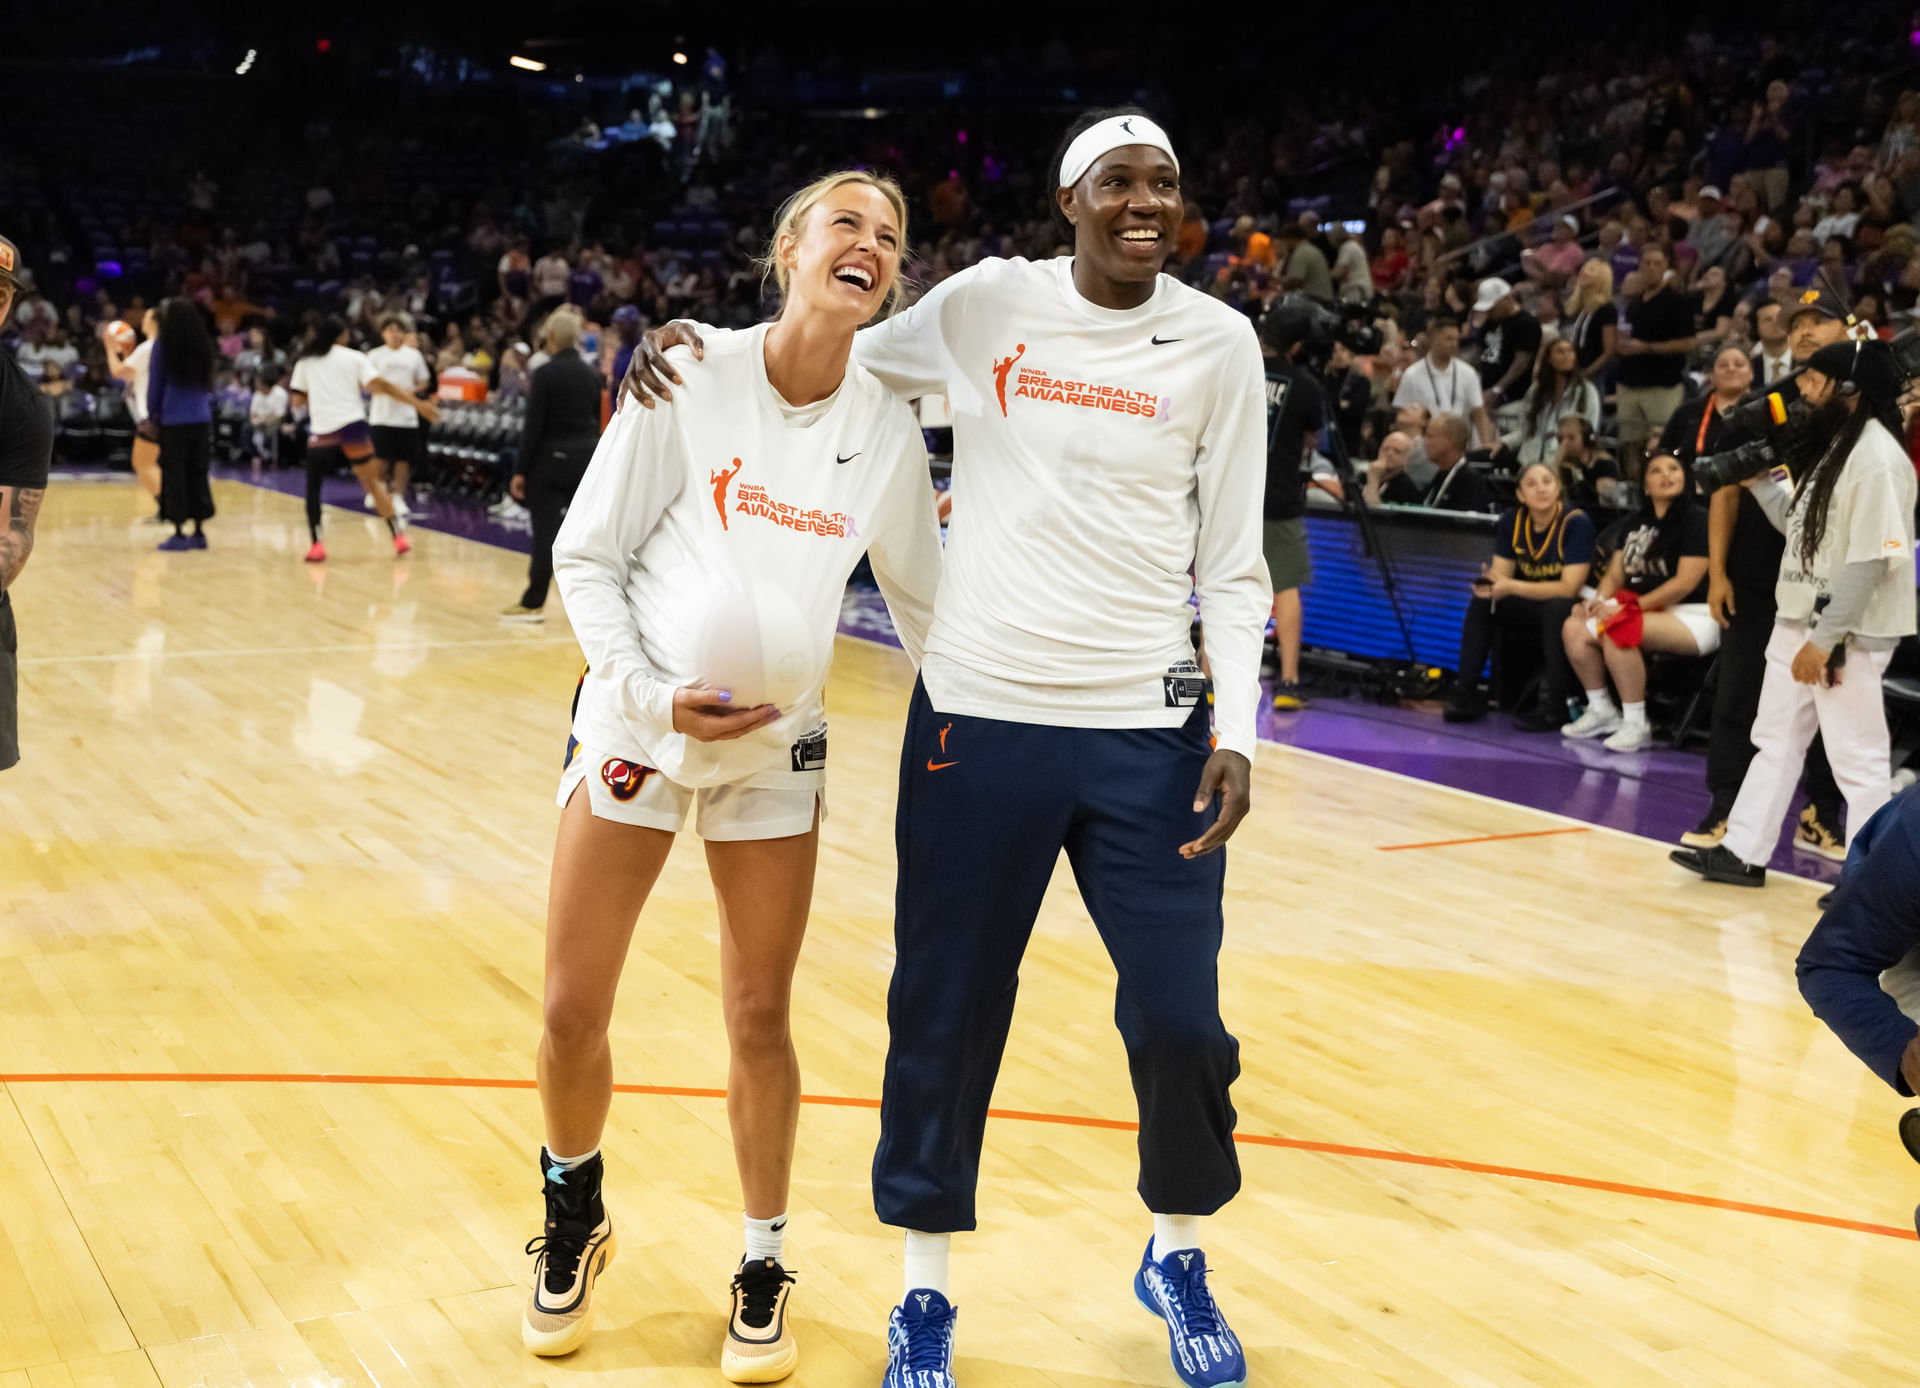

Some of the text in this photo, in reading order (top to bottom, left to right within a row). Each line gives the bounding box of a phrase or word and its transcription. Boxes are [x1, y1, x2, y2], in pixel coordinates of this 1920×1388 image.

[1020, 367, 1047, 377] WNBA
[1014, 384, 1157, 418] AWARENESS
[1017, 373, 1158, 405] BREAST HEALTH
[739, 482, 766, 492] WNBA
[737, 489, 798, 516] BREAST
[736, 501, 845, 539] AWARENESS
